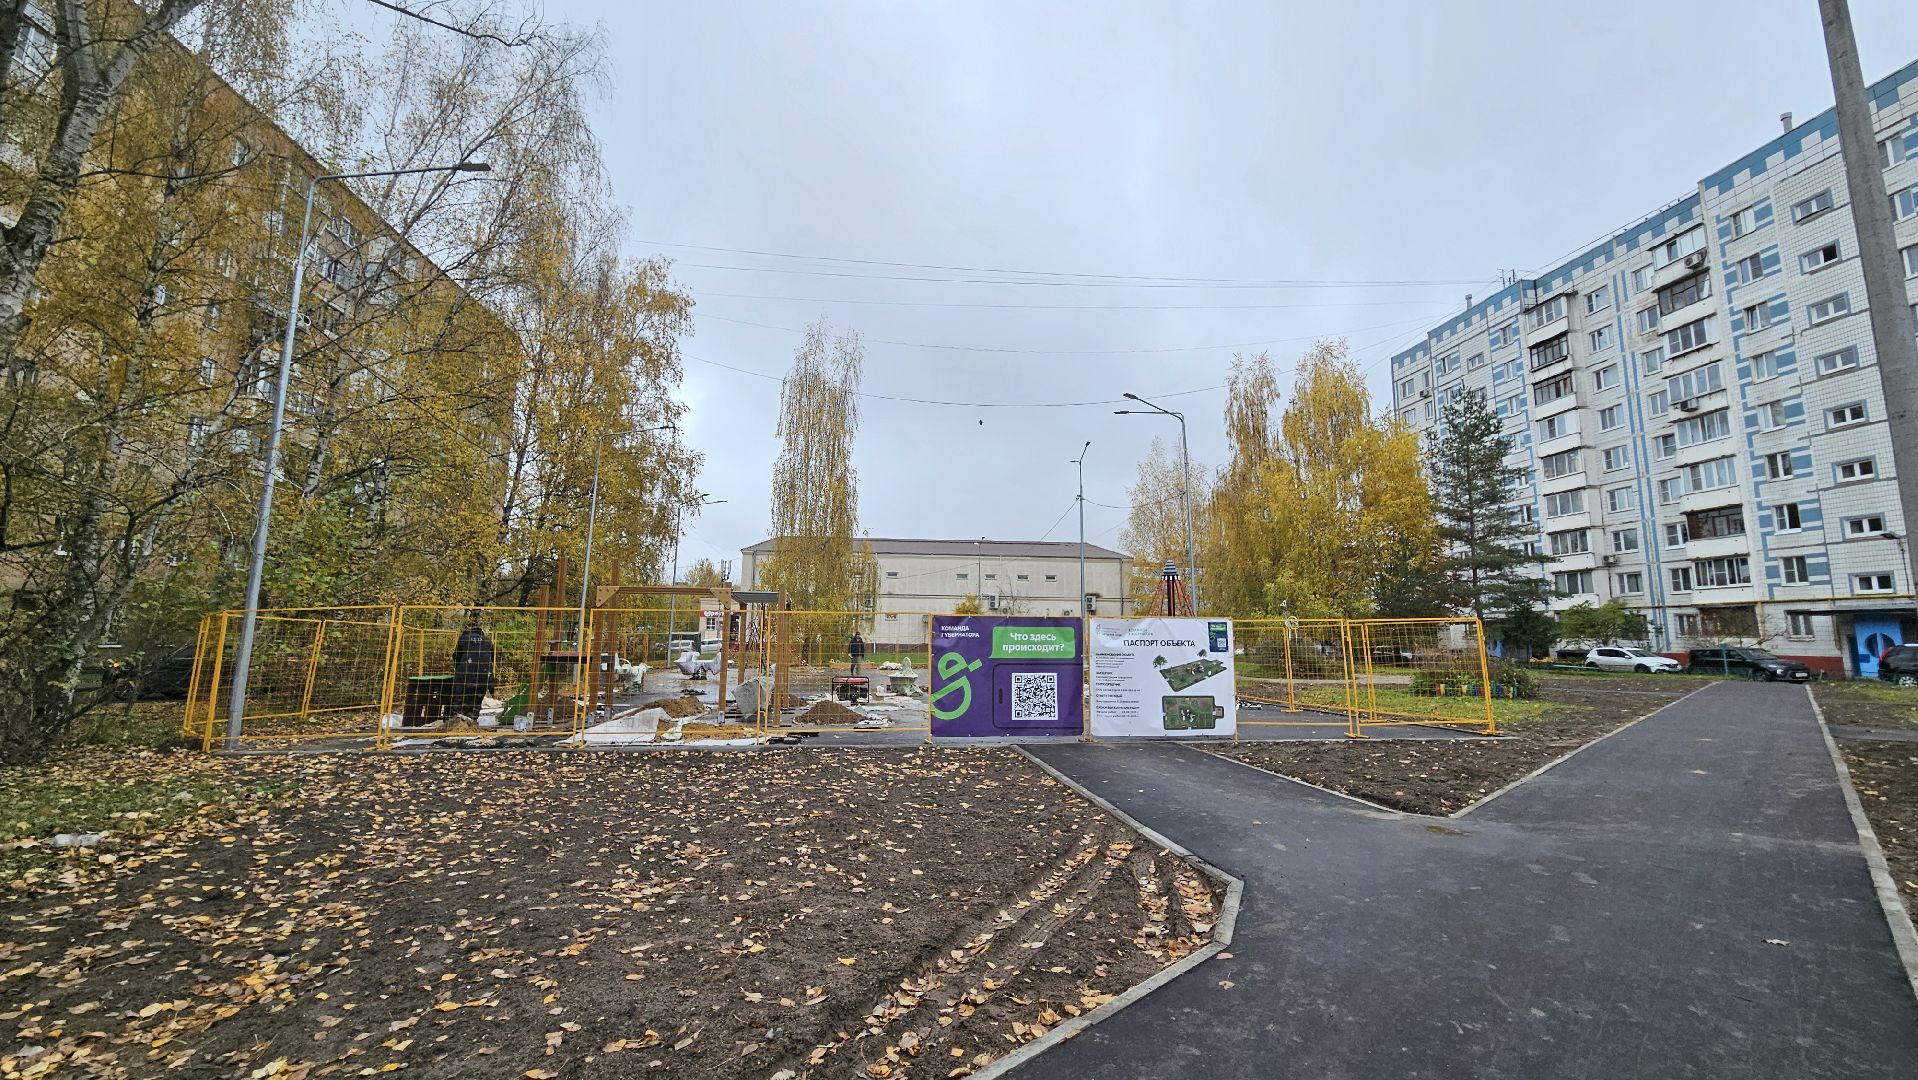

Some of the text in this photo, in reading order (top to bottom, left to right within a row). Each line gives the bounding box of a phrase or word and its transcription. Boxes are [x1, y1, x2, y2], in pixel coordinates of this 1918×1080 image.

[1010, 632, 1057, 642] Что здесь
[1002, 643, 1065, 653] происходит?
[1123, 639, 1196, 647] ПАСПОРТ ОБЪЕКТА
